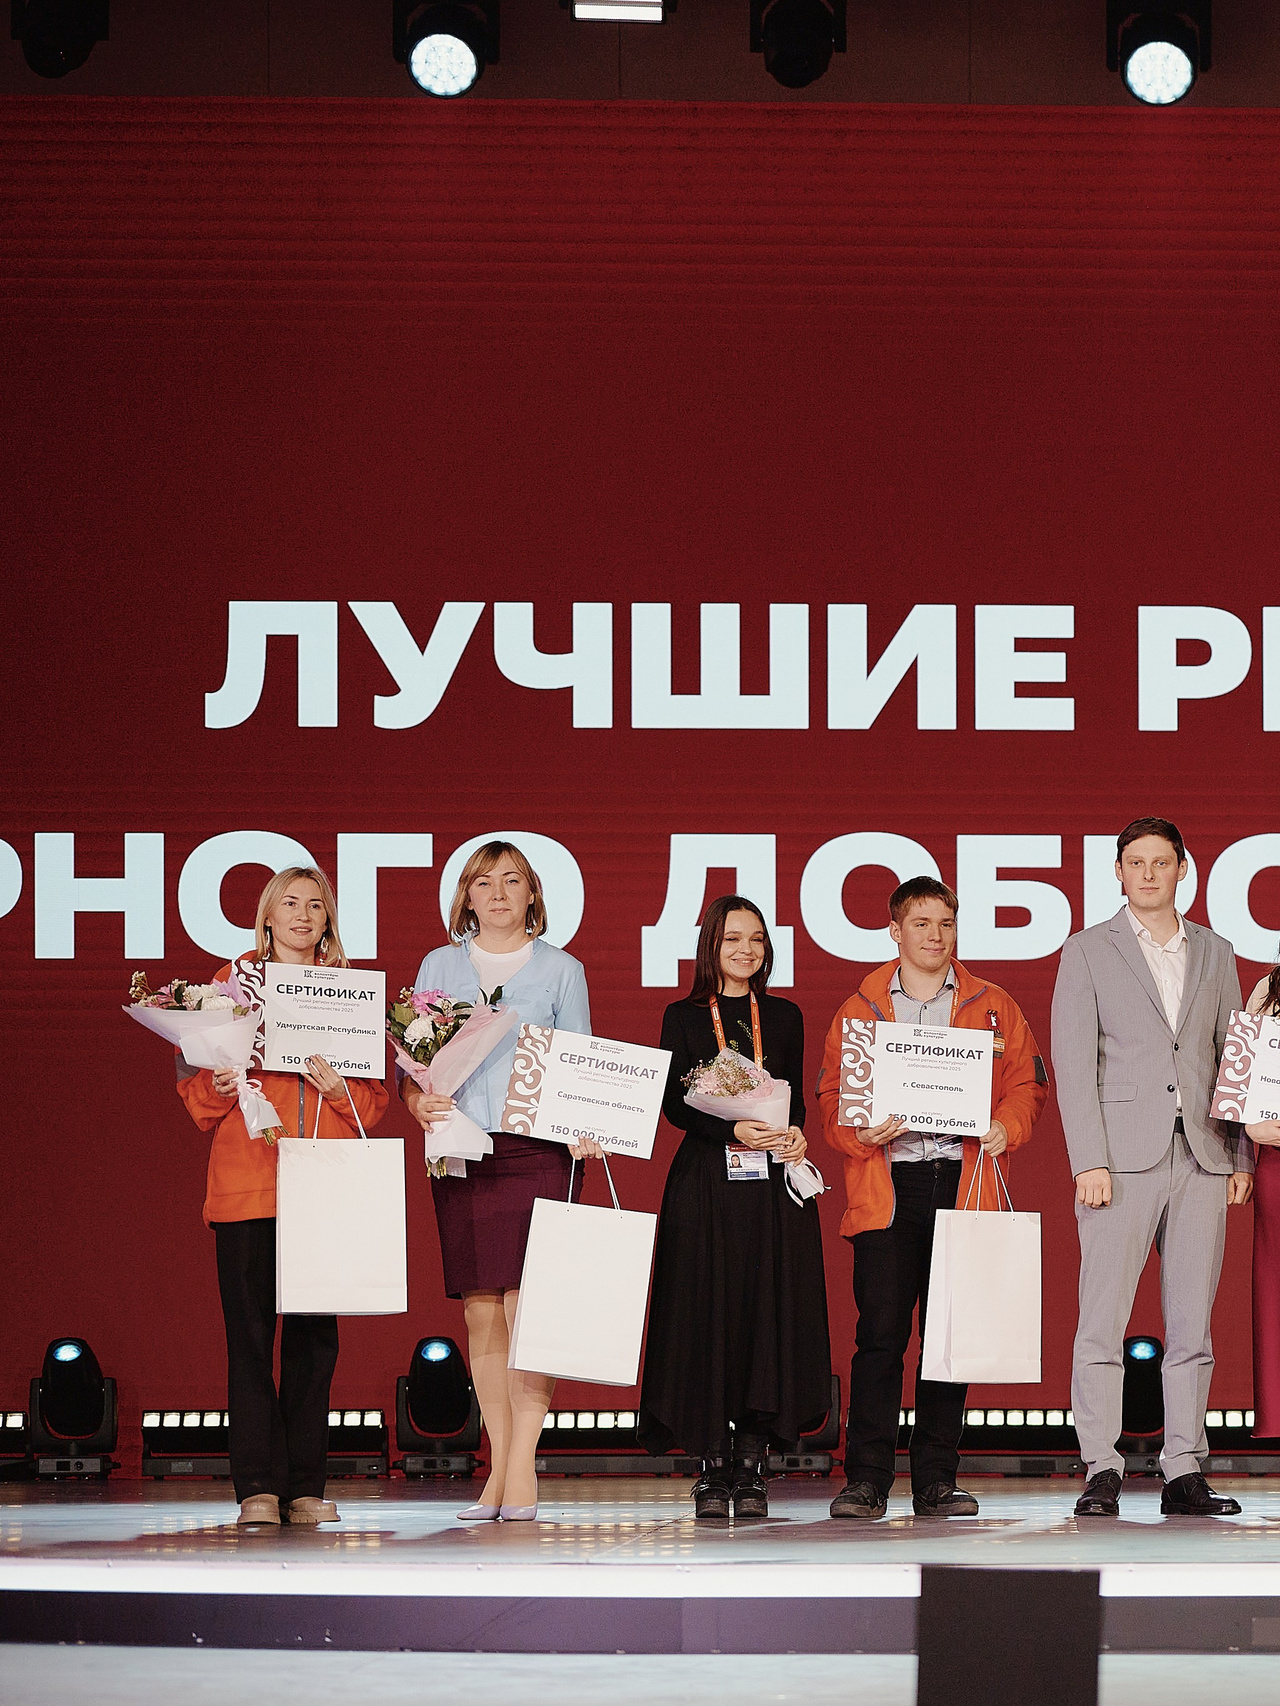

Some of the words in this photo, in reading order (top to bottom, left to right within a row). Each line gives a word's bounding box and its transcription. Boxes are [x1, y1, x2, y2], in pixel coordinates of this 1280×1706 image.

[204, 600, 1075, 731] ЛУЧШИЕ
[0, 830, 586, 961] НОГО
[276, 984, 376, 1001] СЕРТИФИКАТ
[276, 1021, 325, 1031] Удмуртская
[327, 1025, 376, 1035] Республика
[886, 1042, 984, 1060] СЕРТИФИКАТ
[281, 1056, 301, 1065] 150
[330, 1060, 371, 1070] рублей
[559, 1052, 659, 1080] СЕРТИФИКАТ
[910, 1081, 964, 1092] Севастополь
[557, 1091, 610, 1106] Саратовская
[611, 1102, 645, 1113] область
[888, 1113, 907, 1122] 50
[910, 1115, 933, 1124] 000
[936, 1118, 976, 1128] рублей
[1259, 1110, 1278, 1120] 150
[551, 1124, 570, 1135] 150
[572, 1129, 595, 1140] 000
[597, 1135, 638, 1149] рублей
